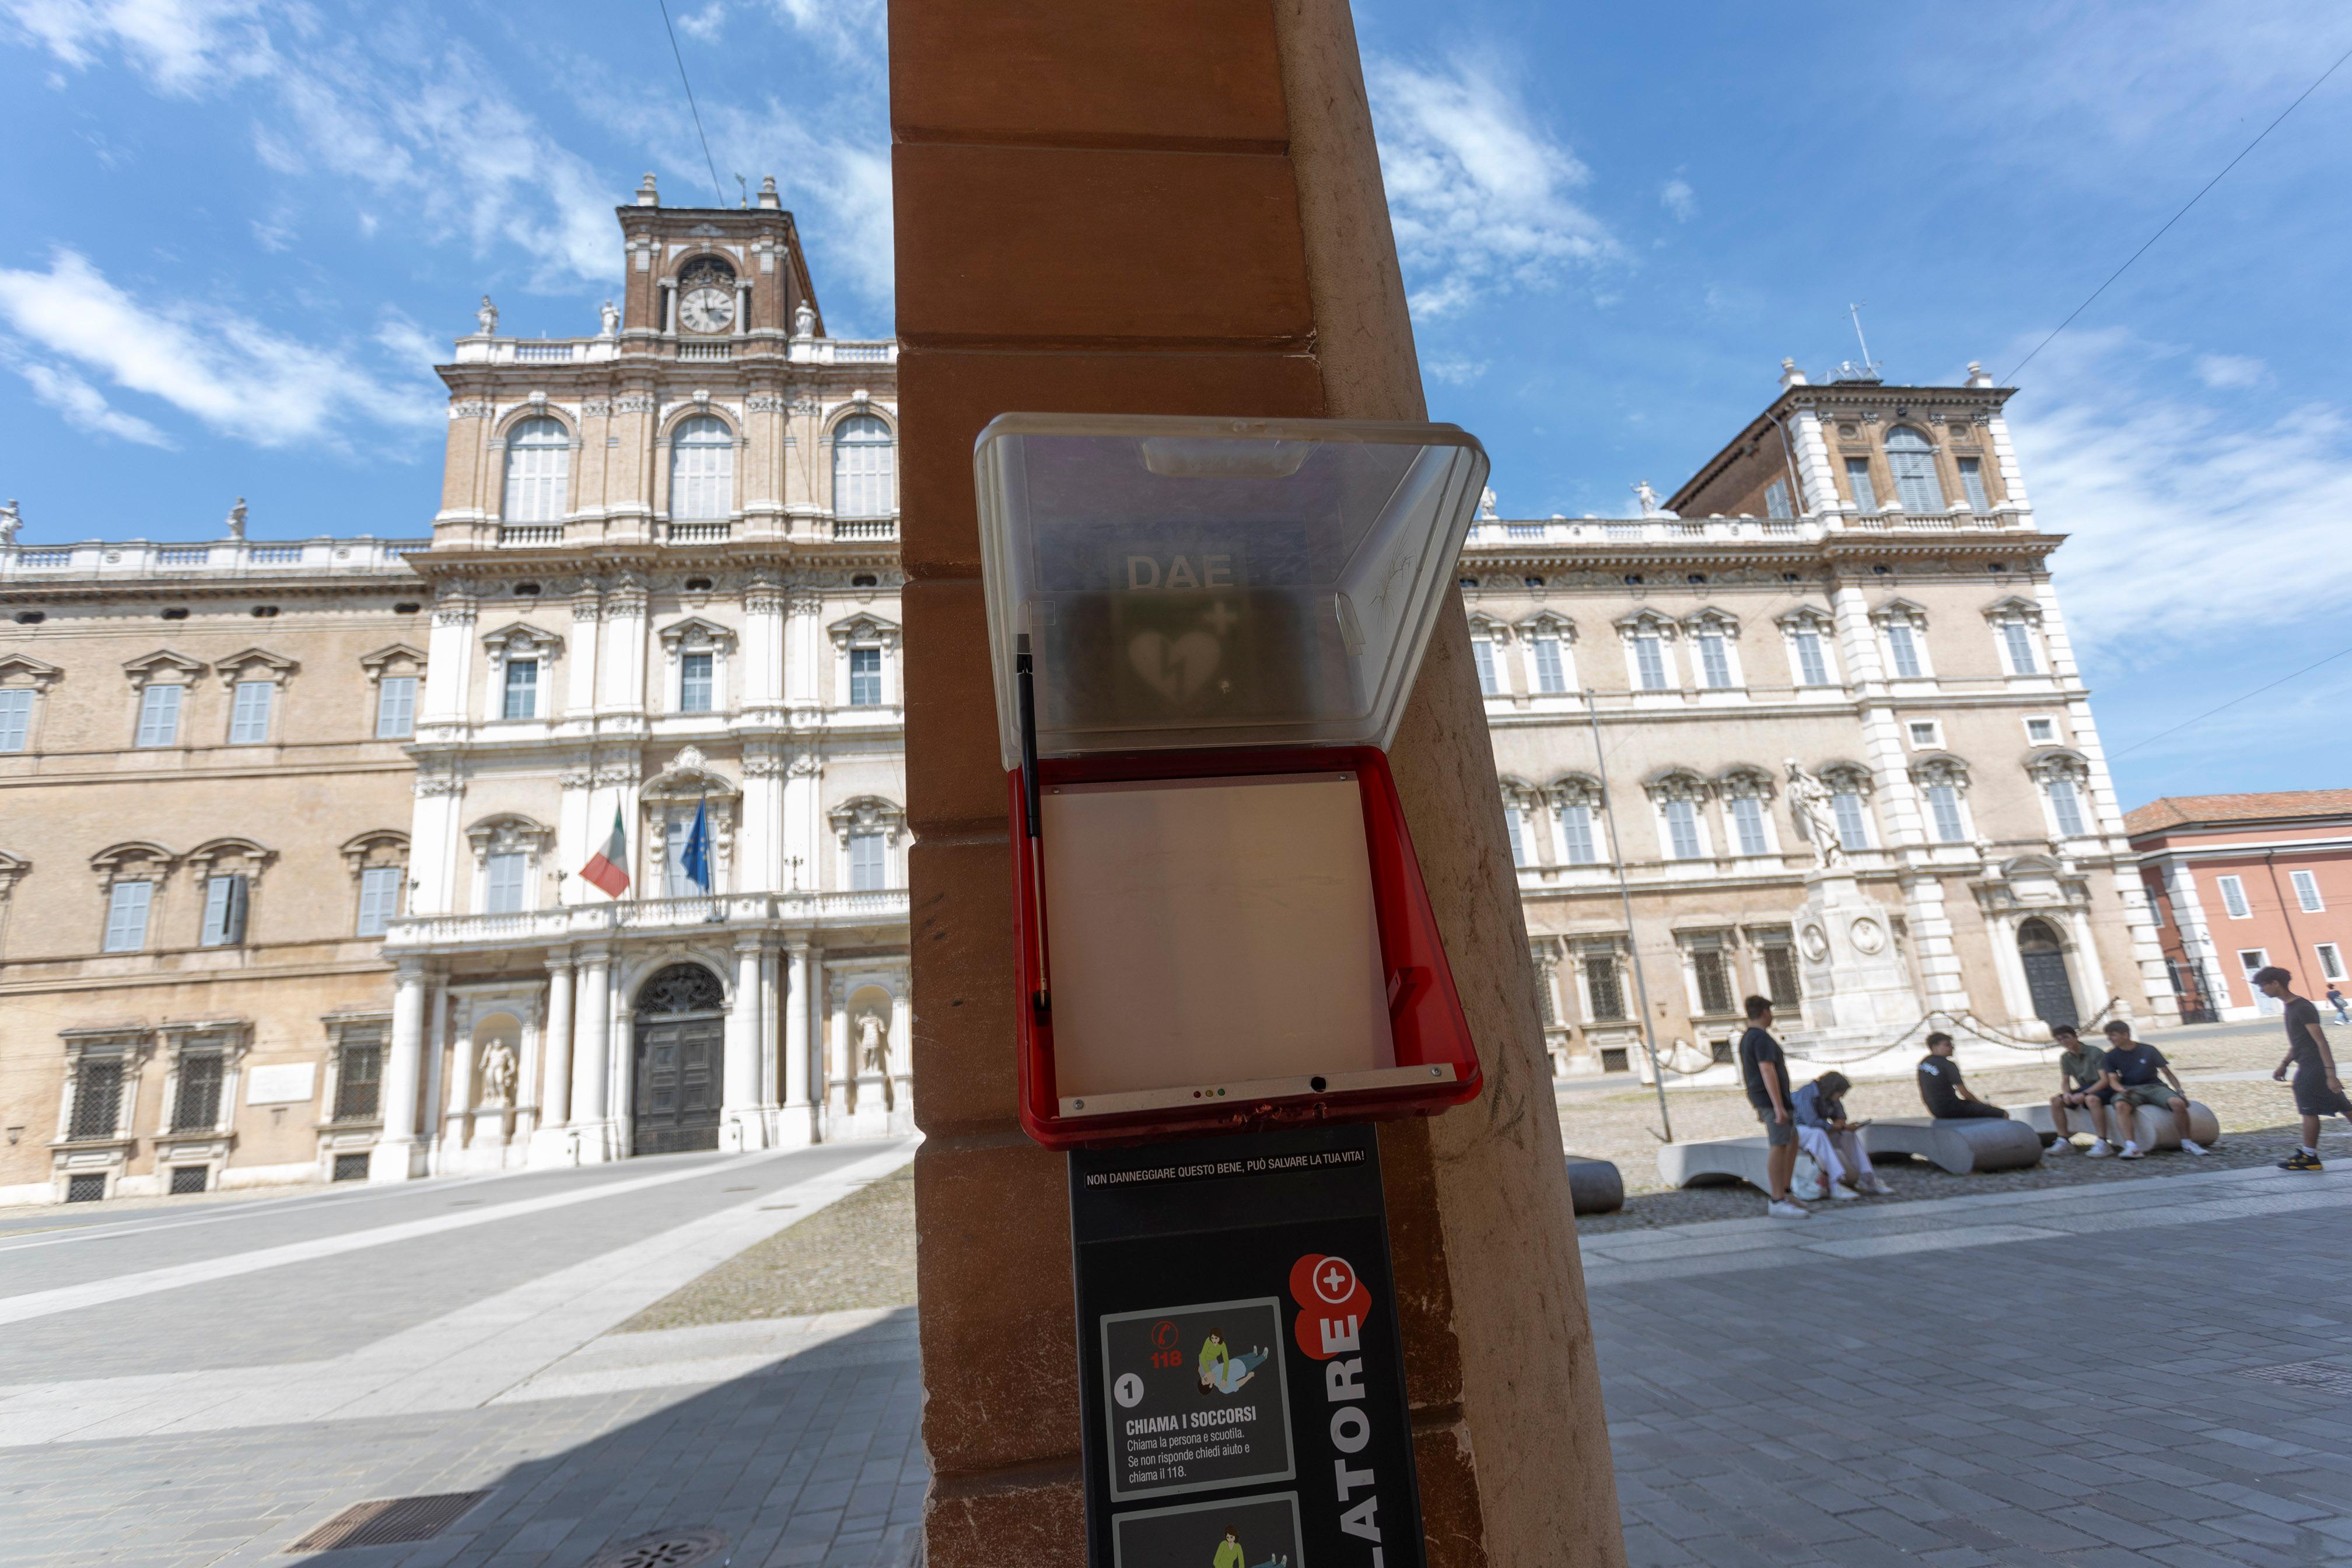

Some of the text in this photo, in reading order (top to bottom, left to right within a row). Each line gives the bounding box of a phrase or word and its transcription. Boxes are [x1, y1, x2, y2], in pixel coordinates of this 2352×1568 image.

[1127, 555, 1234, 590] DAE
[1087, 1150, 1364, 1186] NON DANNEGGIARE QUESTO BENE, PUÒ SALVARE LA TUA VITA!
[1150, 1350, 1182, 1369] 118
[1124, 1380, 1133, 1399] 1
[1126, 1406, 1256, 1436] CHIAMA I SOCCORSI
[1127, 1427, 1245, 1452] Chiama la persona e scuotila.
[1128, 1444, 1250, 1468] Se non risponde chiedi aiuto e
[1129, 1465, 1186, 1483] chiama il 118.
